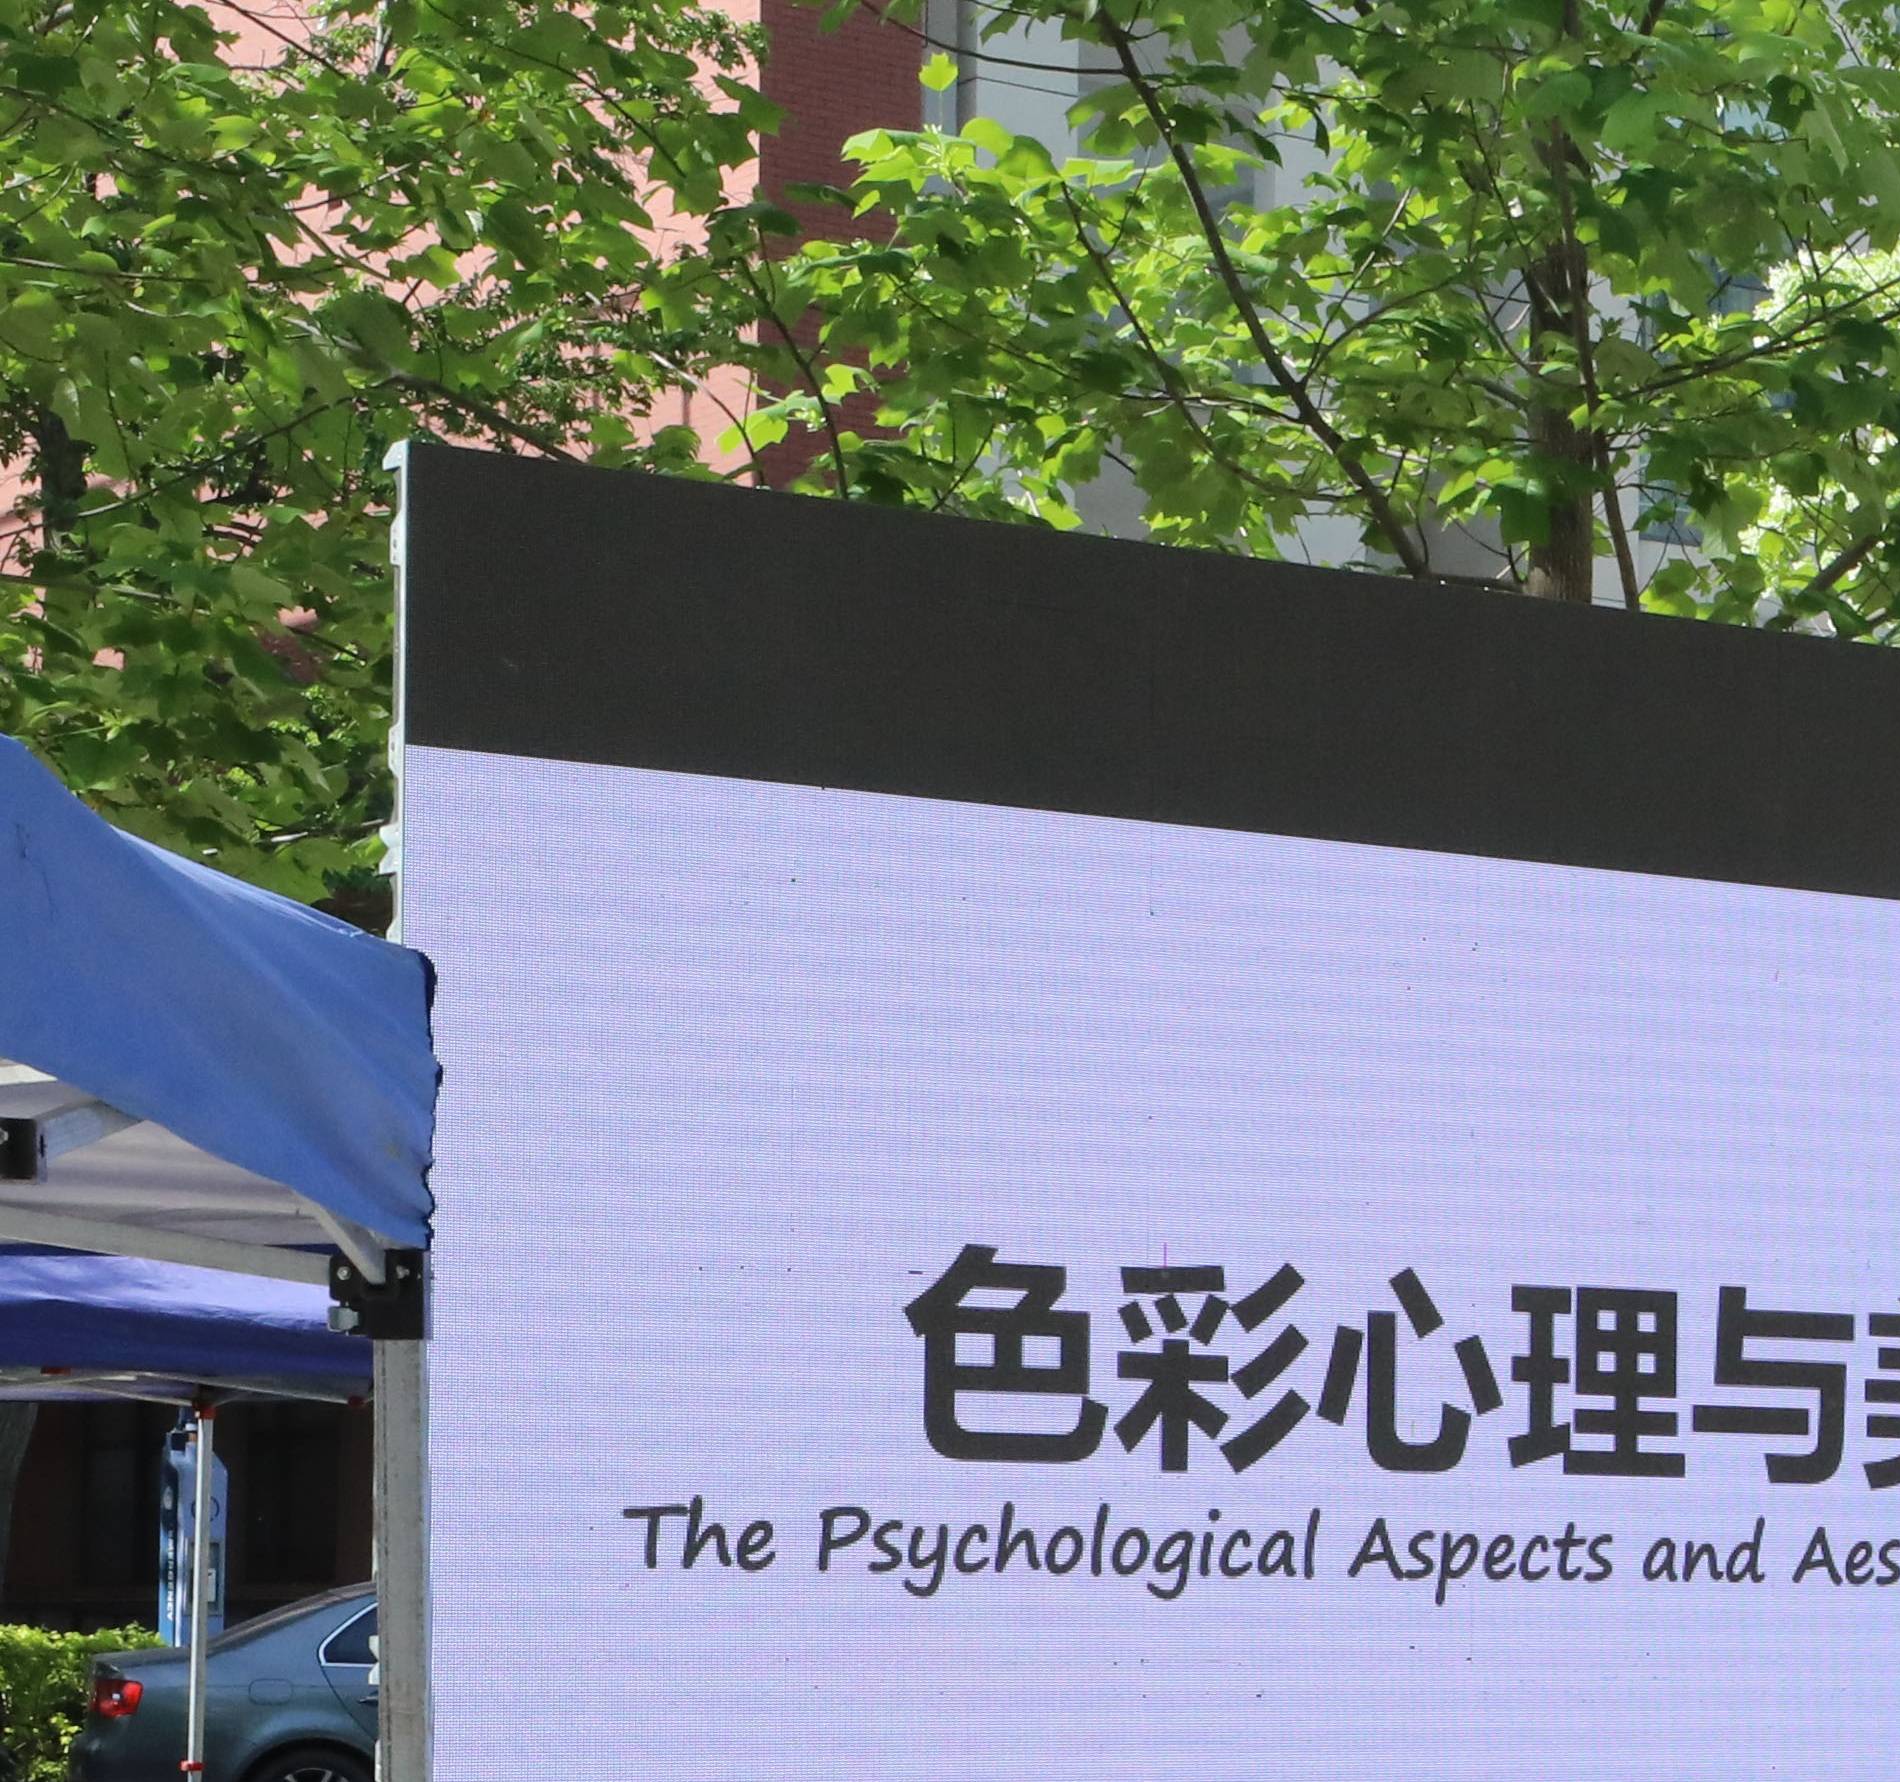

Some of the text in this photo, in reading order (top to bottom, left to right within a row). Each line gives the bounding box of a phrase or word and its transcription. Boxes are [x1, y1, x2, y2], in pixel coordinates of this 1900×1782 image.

[622, 1494, 776, 1573] The
[817, 1501, 1321, 1601] Psychological
[1347, 1517, 1614, 1606] Aspects
[1642, 1516, 1766, 1584] and
